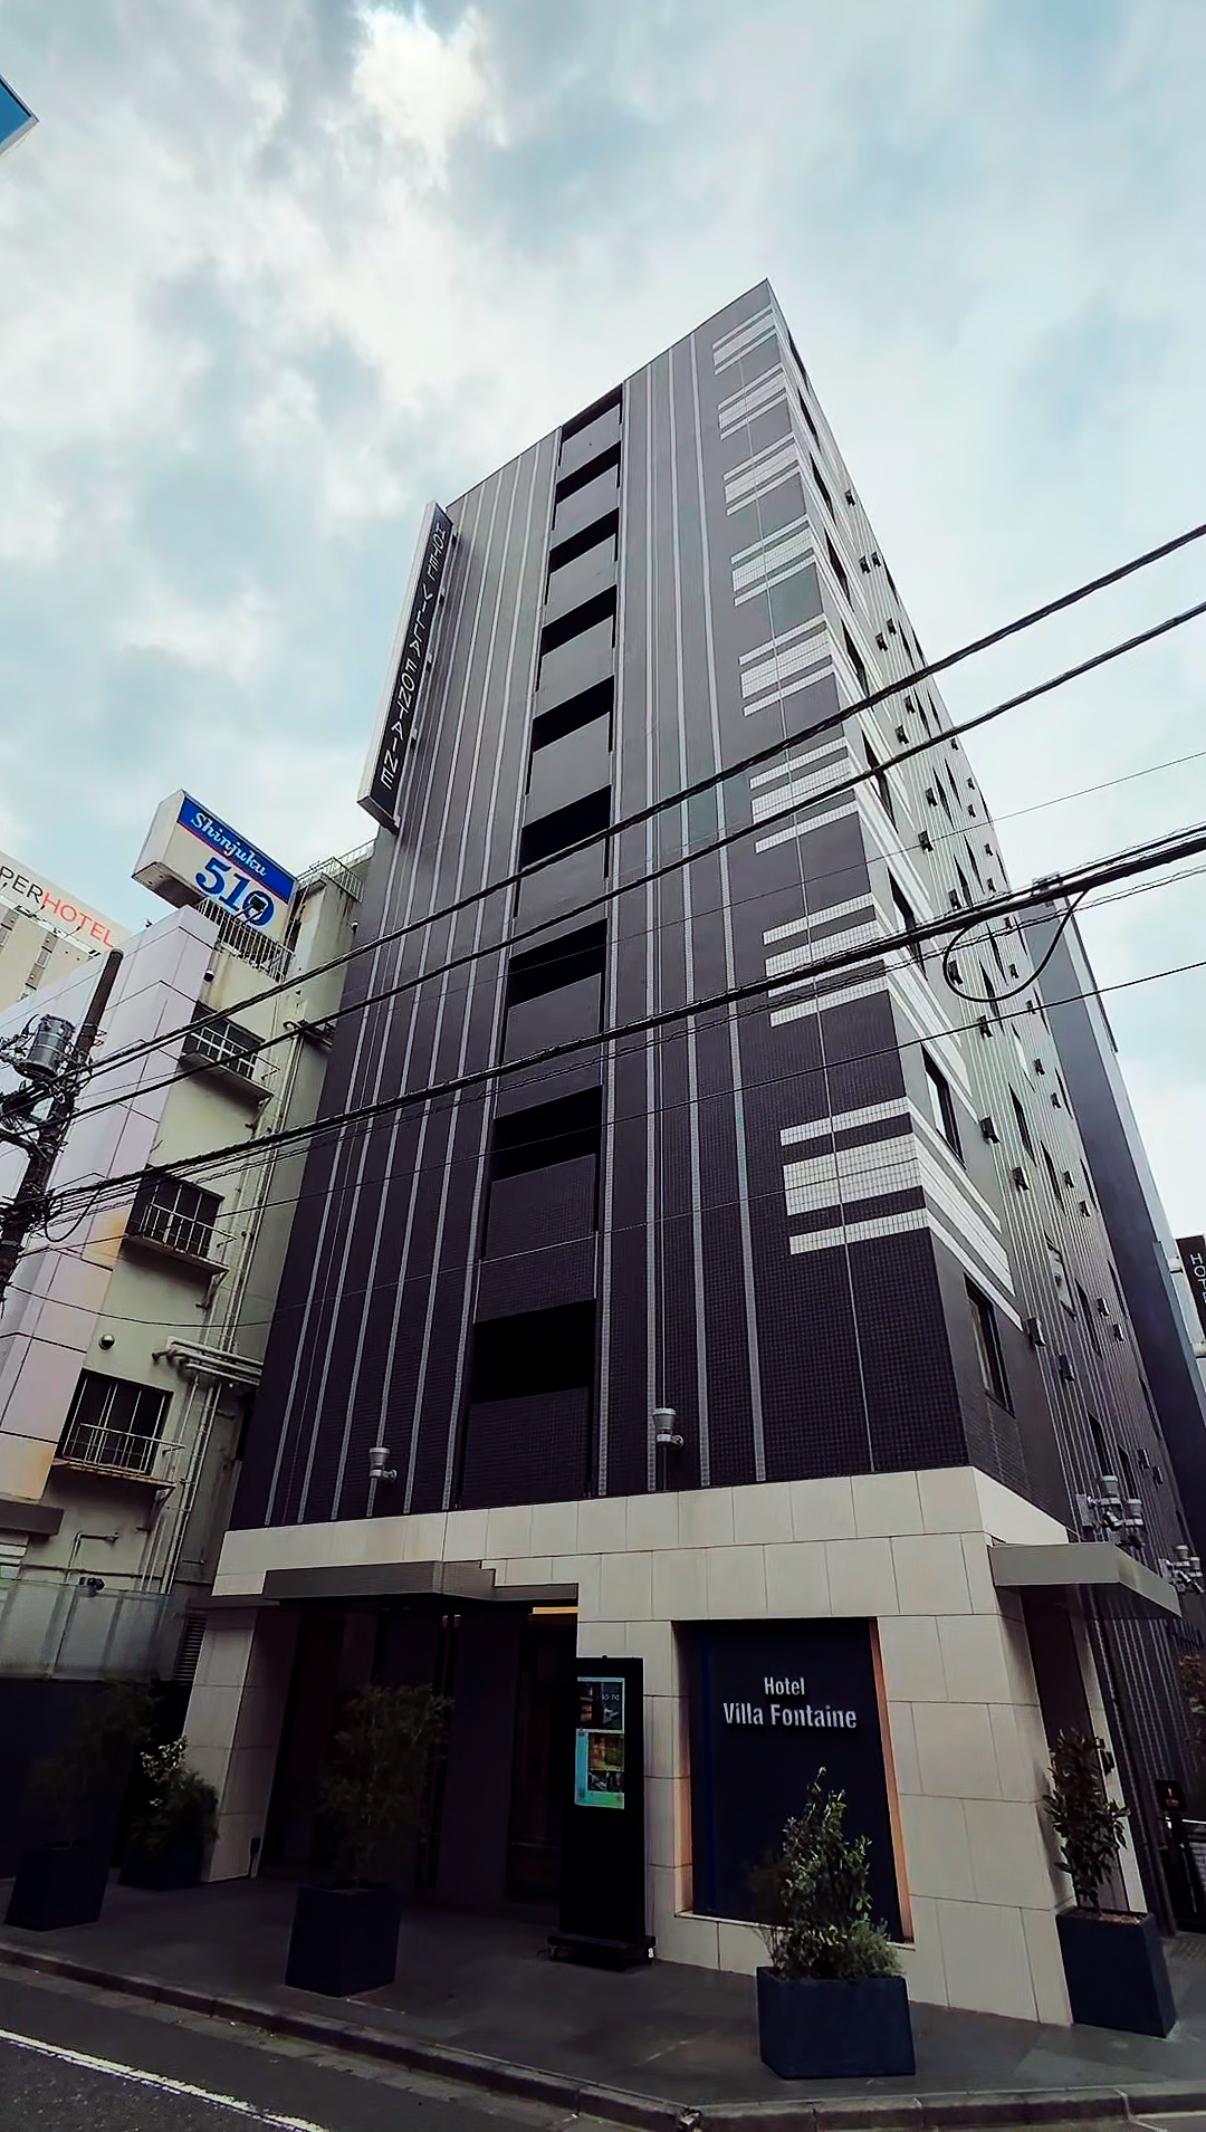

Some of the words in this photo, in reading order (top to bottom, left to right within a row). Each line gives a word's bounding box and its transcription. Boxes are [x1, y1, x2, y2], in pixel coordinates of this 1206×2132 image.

[428, 522, 446, 581] HOTEL
[409, 583, 433, 659] VILLA
[380, 658, 417, 790] FONTAINE
[191, 812, 267, 877] Shinjuku
[195, 857, 275, 926] 510
[723, 1702, 764, 1725] Villa
[770, 1703, 857, 1729] Fontaine
[764, 1676, 806, 1695] Hotel
